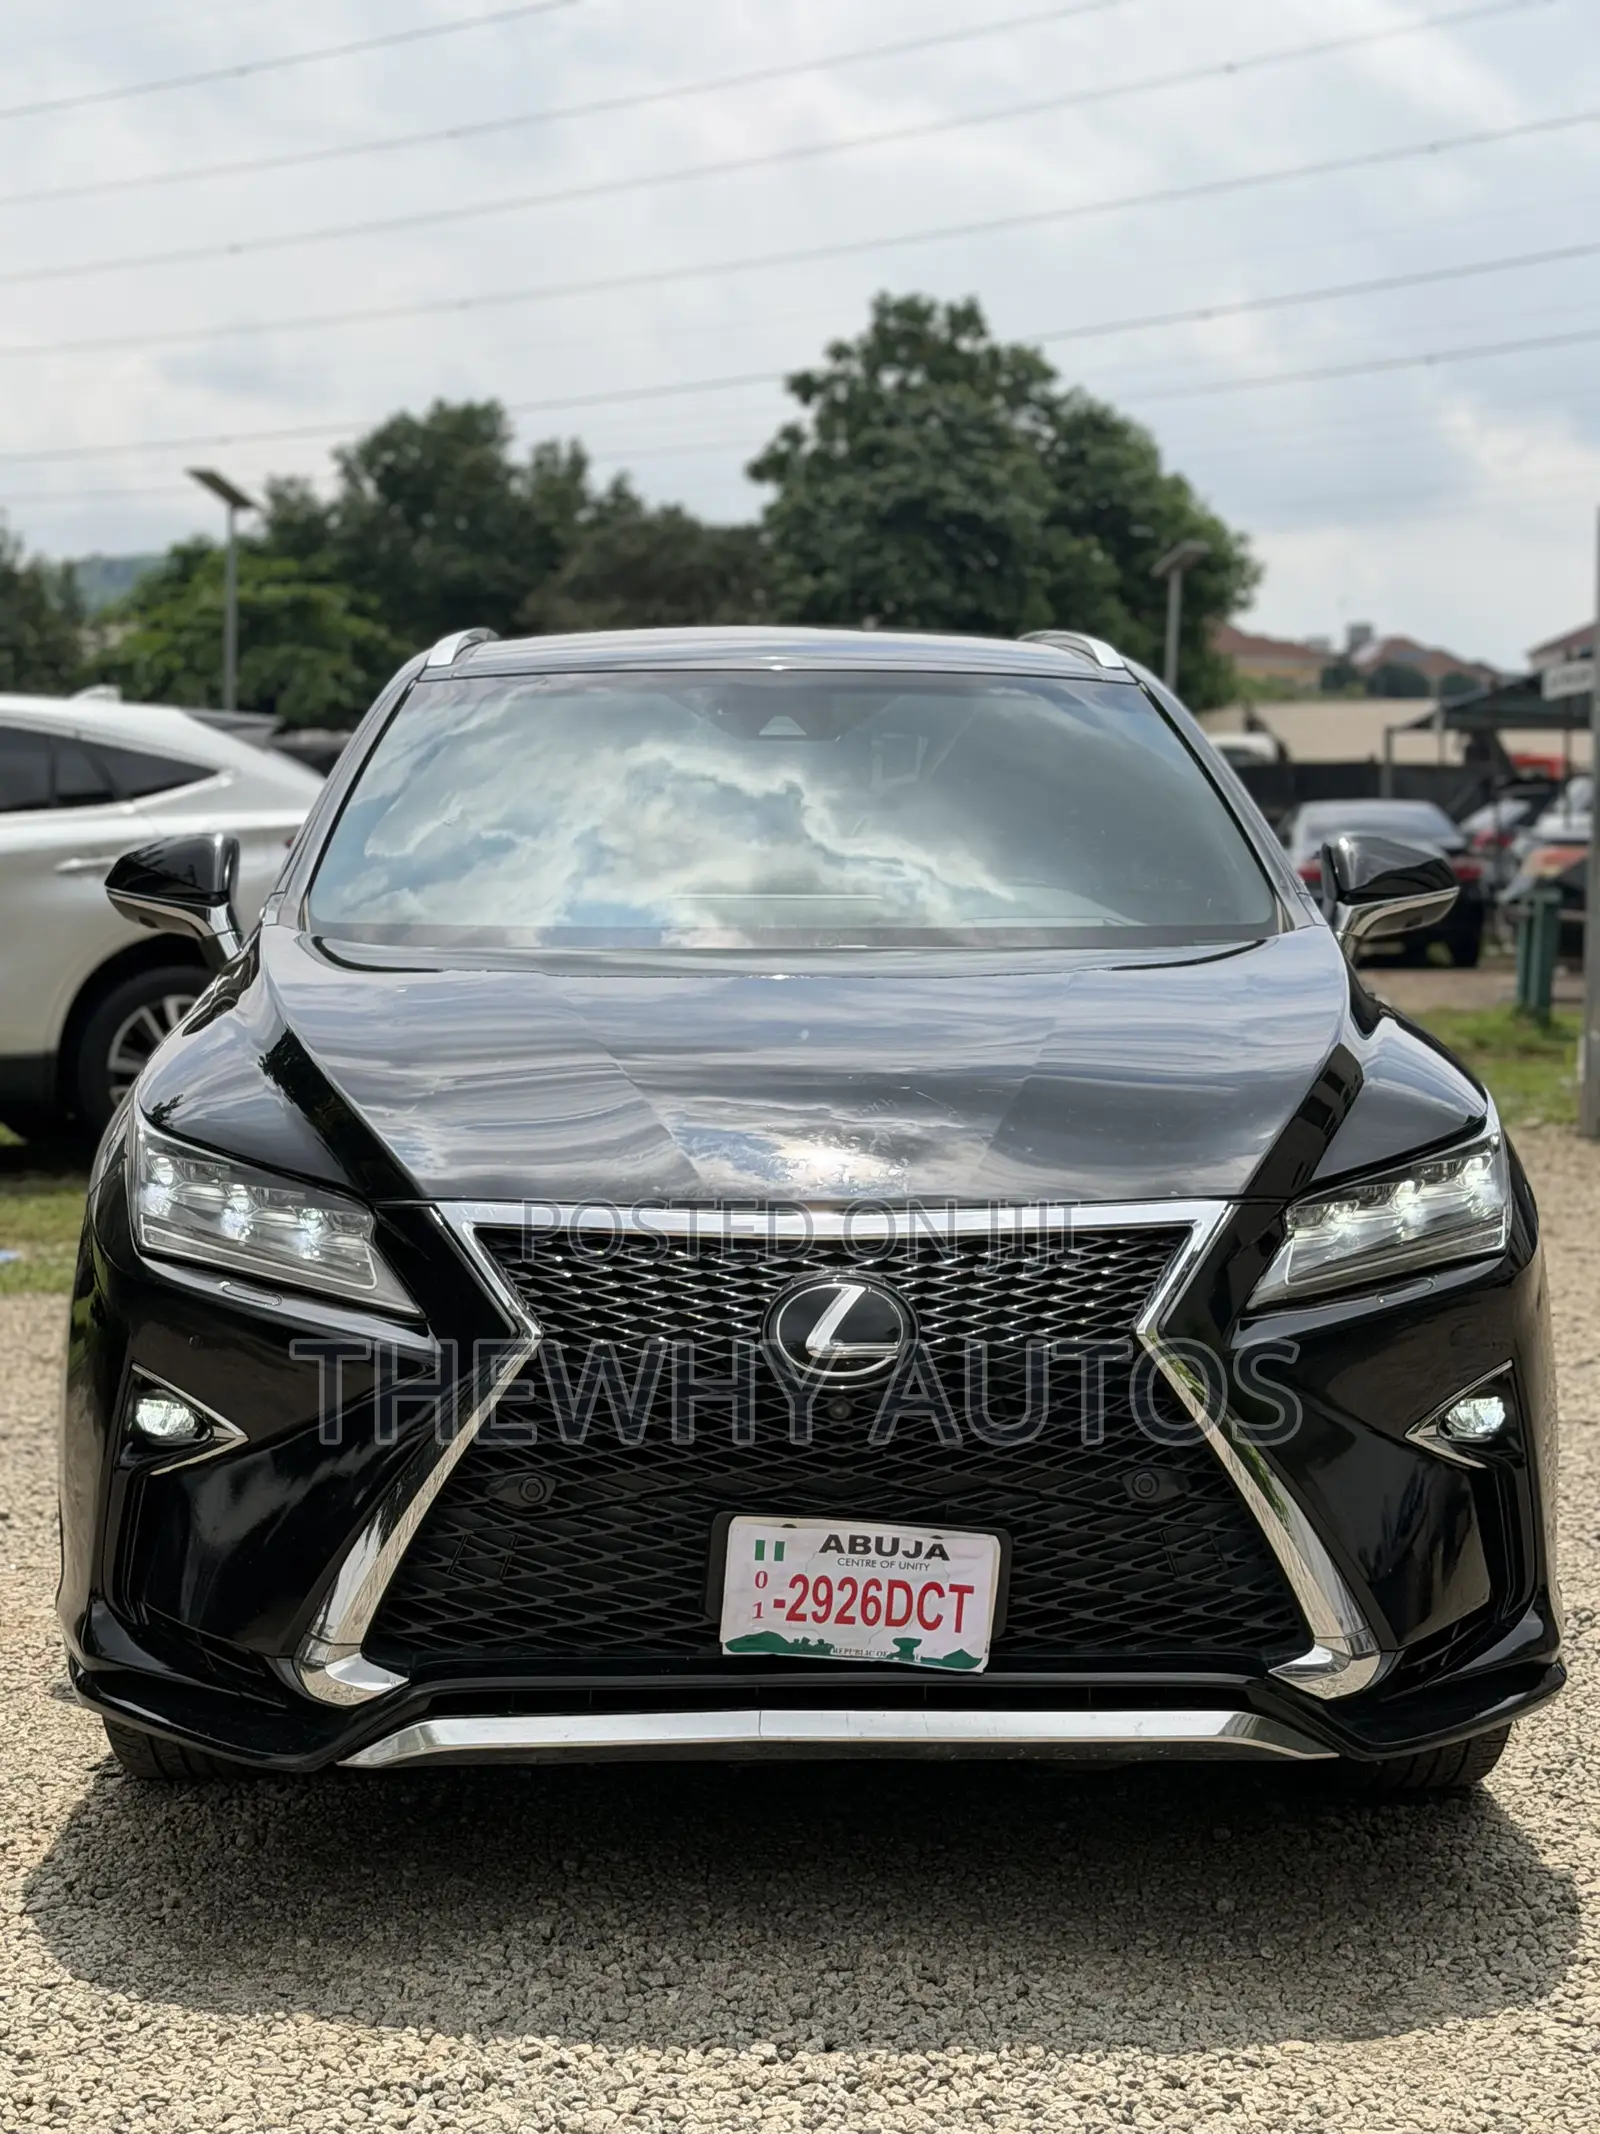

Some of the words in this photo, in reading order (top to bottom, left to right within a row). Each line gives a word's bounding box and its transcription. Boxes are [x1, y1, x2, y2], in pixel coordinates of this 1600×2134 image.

[819, 1534, 950, 1561] ABUJA
[837, 1557, 877, 1568] CENTRE
[880, 1560, 896, 1569] OF
[898, 1561, 931, 1572] UNITY
